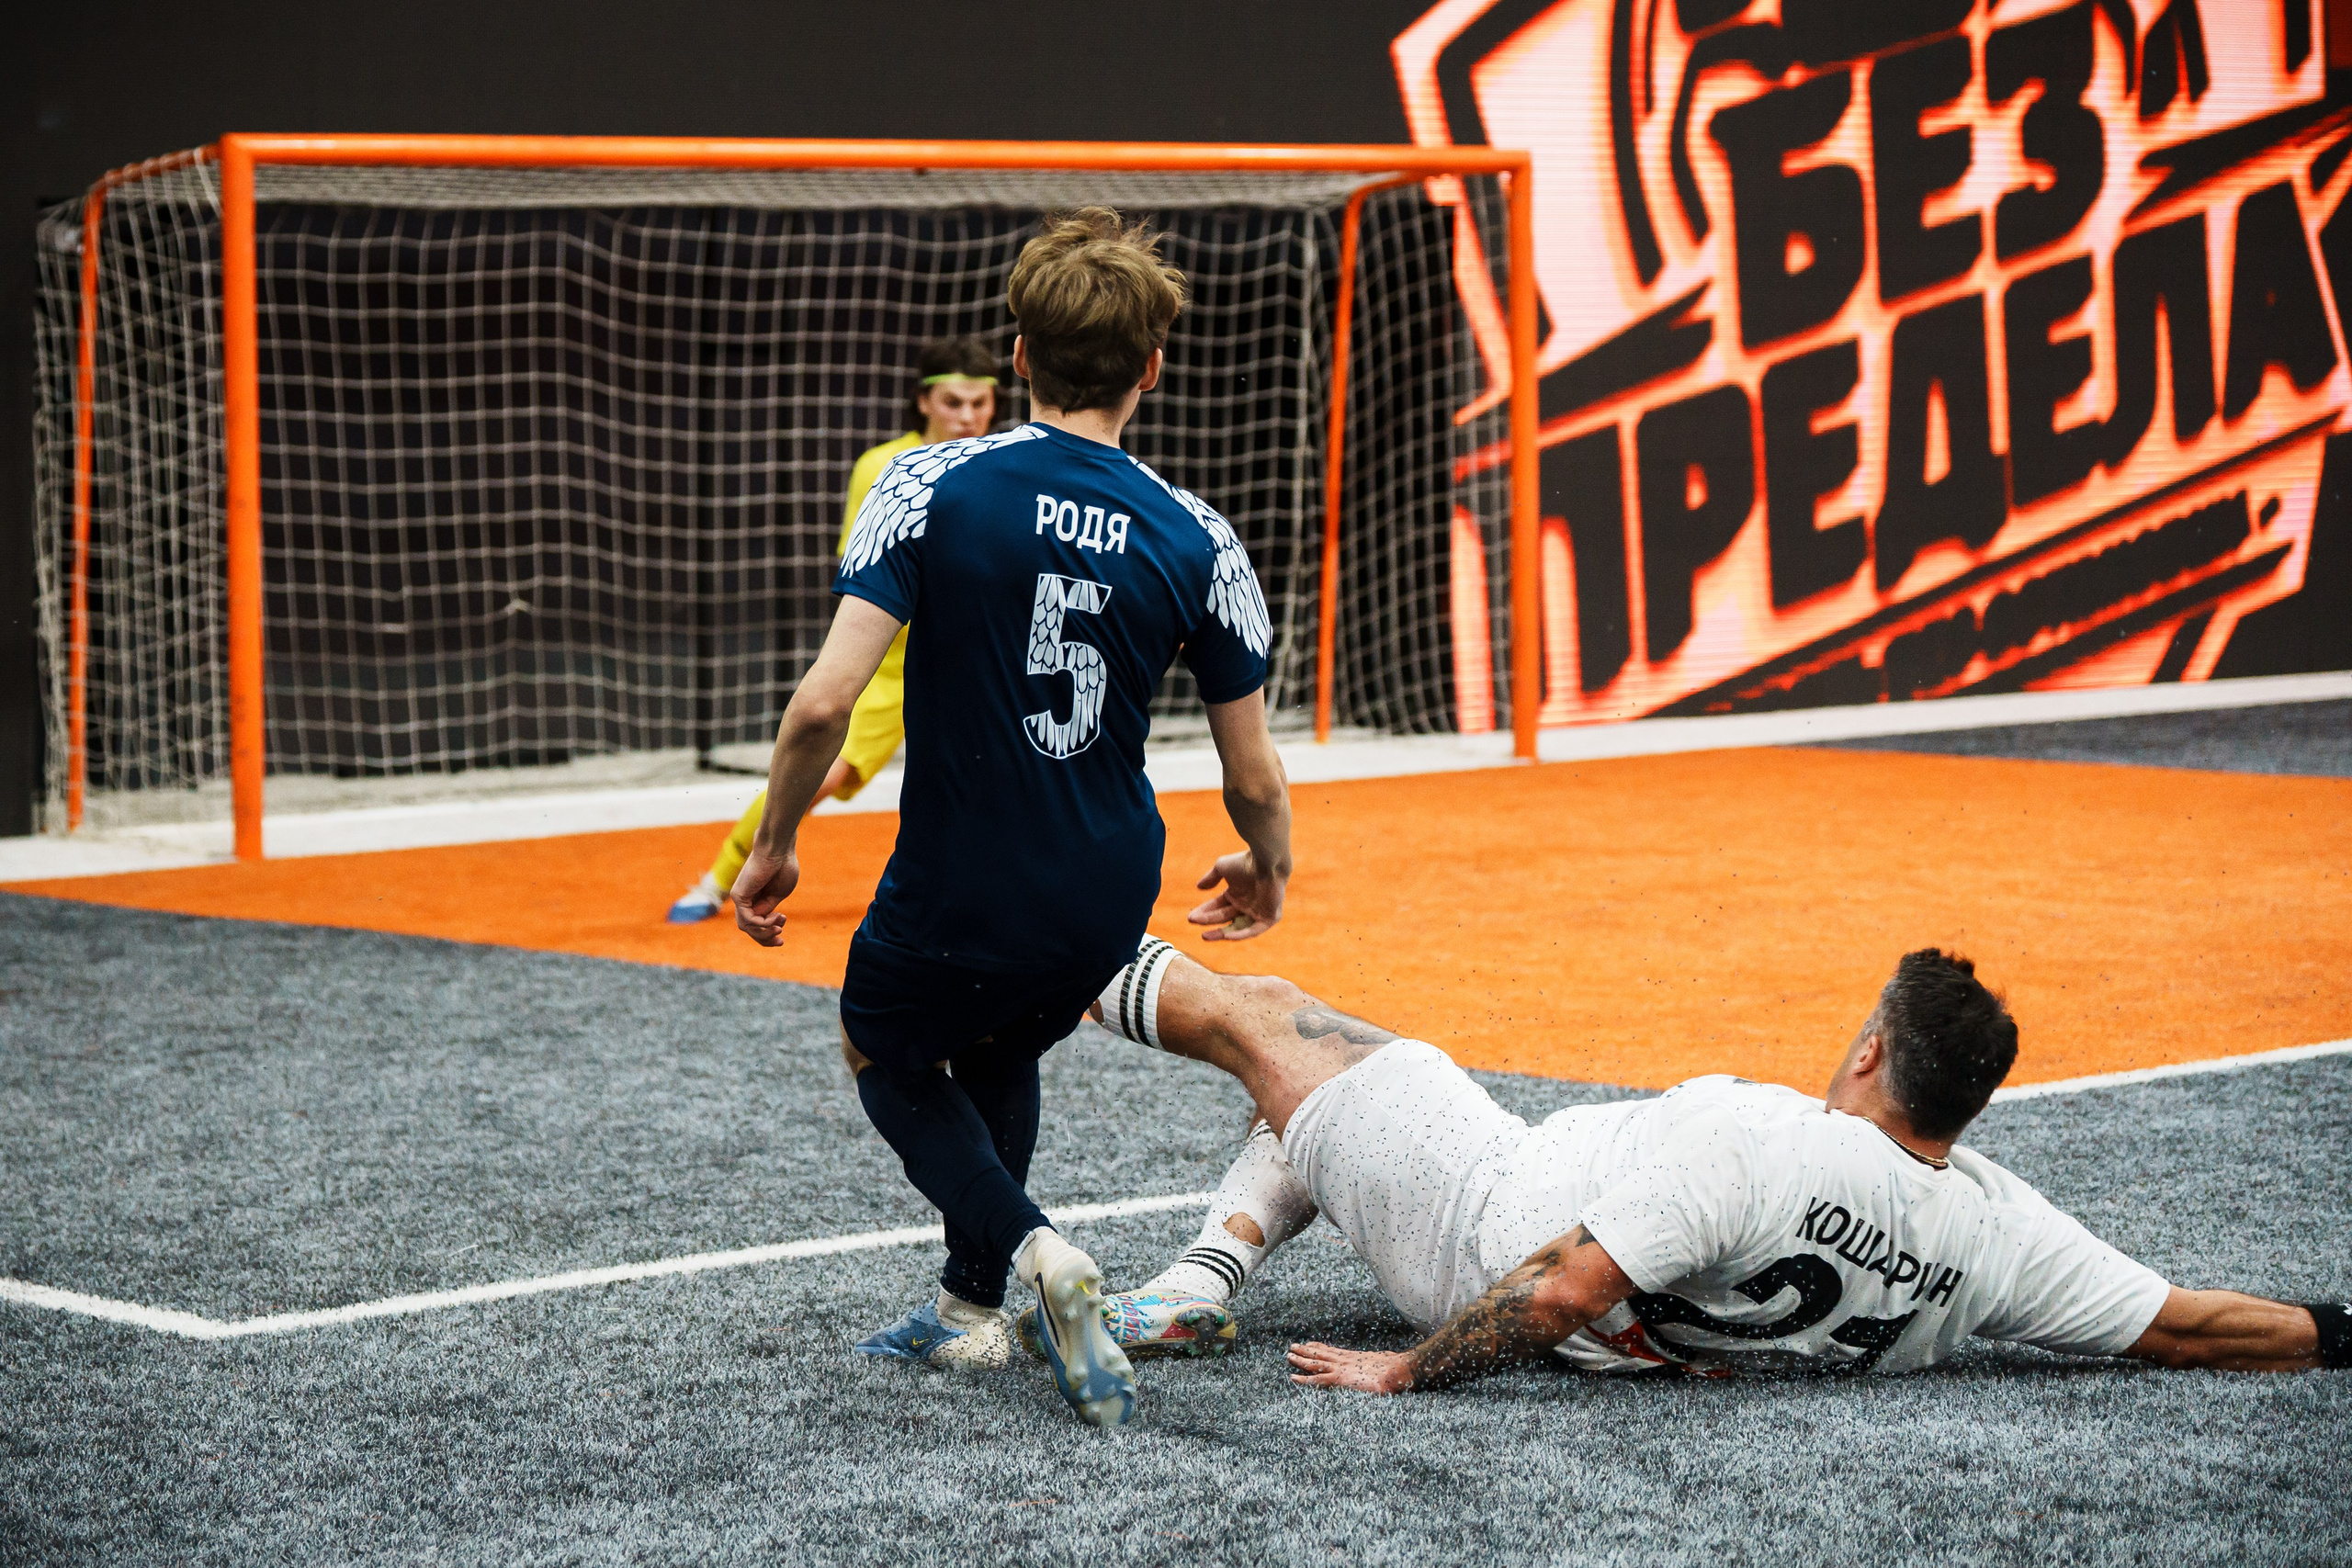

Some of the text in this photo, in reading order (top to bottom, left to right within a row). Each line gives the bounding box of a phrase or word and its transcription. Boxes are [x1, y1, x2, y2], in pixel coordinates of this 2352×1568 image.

[1705, 5, 2105, 350] БЕЗ
[1035, 494, 1131, 554] РОДЯ
[1470, 177, 2340, 695] ПРЕДЕЛА
[1023, 573, 1113, 760] 5
